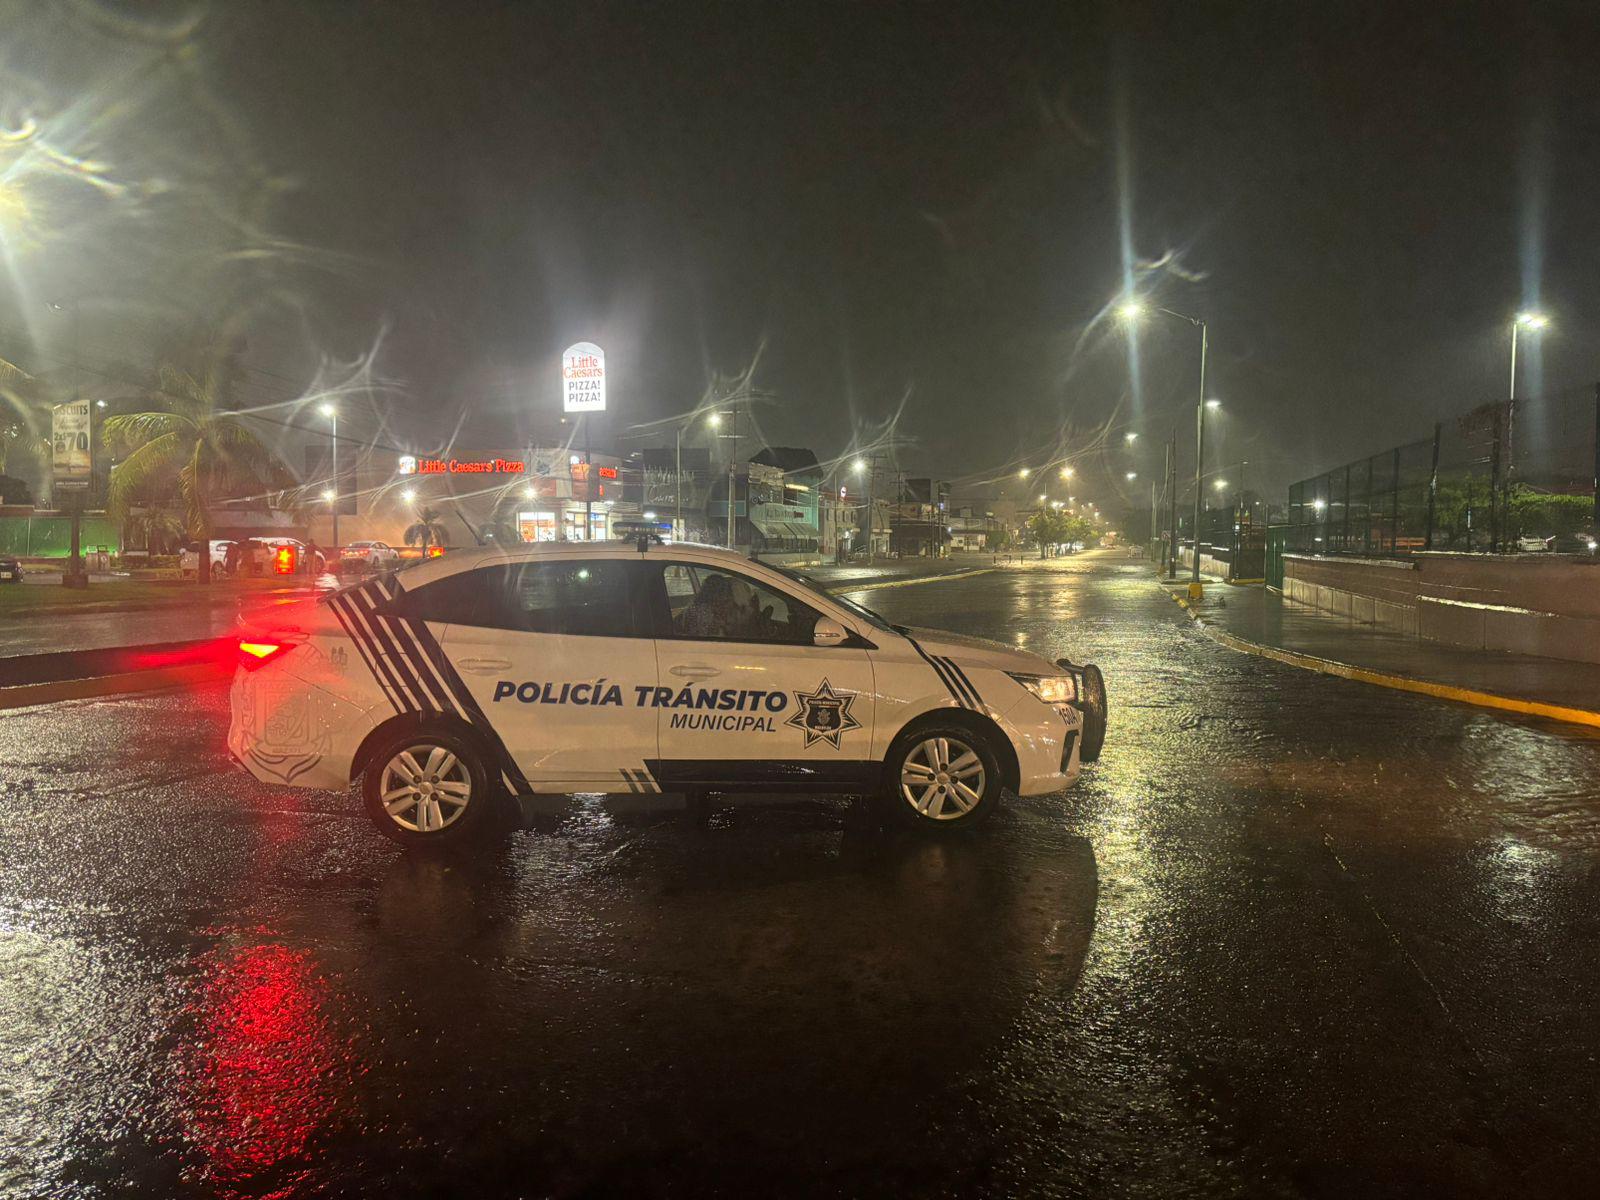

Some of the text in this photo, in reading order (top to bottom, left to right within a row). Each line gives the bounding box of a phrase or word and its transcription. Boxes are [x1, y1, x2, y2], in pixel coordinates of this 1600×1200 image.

[571, 354, 598, 368] Little
[563, 367, 603, 379] Caesars
[569, 380, 600, 391] PIZZA!
[569, 392, 600, 403] PIZZA!
[418, 459, 524, 474] Little Caesars Pizza
[493, 679, 787, 713] POLICÍA TRÁNSITO
[670, 713, 776, 732] MUNICIPAL
